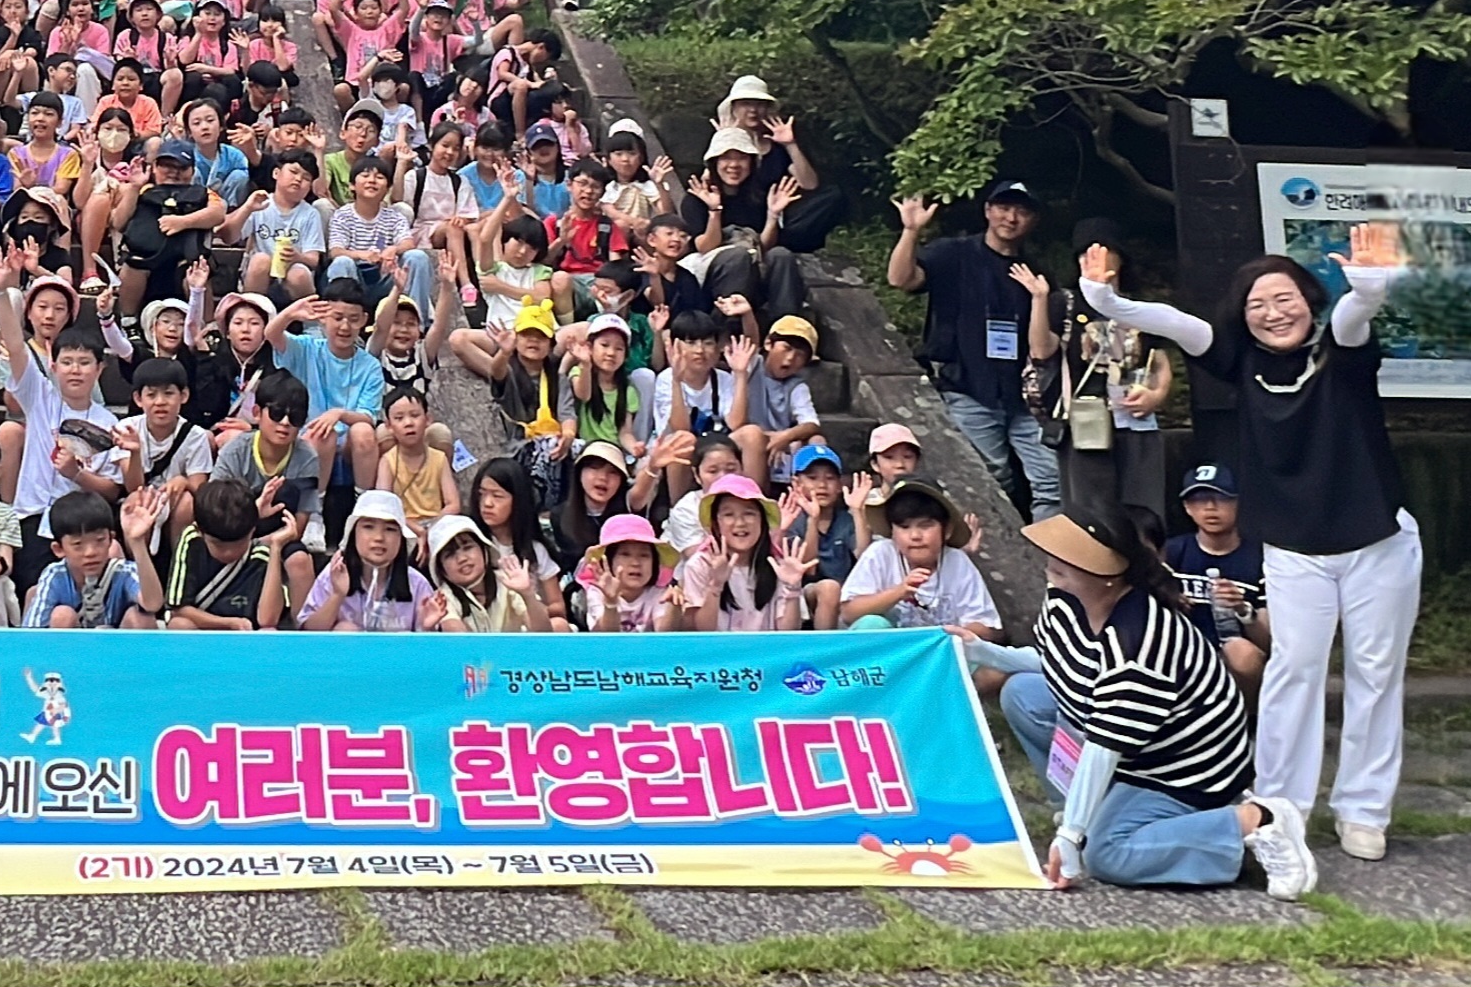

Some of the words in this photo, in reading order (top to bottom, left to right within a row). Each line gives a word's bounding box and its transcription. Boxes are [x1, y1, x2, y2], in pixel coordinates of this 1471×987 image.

[499, 667, 764, 694] 경상남도남해교육지원청
[830, 665, 886, 688] 남해군
[41, 758, 135, 815] 오신
[154, 723, 433, 825] 여러분,
[451, 717, 910, 822] 환영합니다!
[79, 855, 154, 879] (2기)
[163, 855, 281, 878] 2024년
[286, 855, 338, 876] 7월
[347, 854, 454, 877] 4일(목)
[493, 855, 541, 875] 7월
[551, 853, 655, 875] 5일(금)
